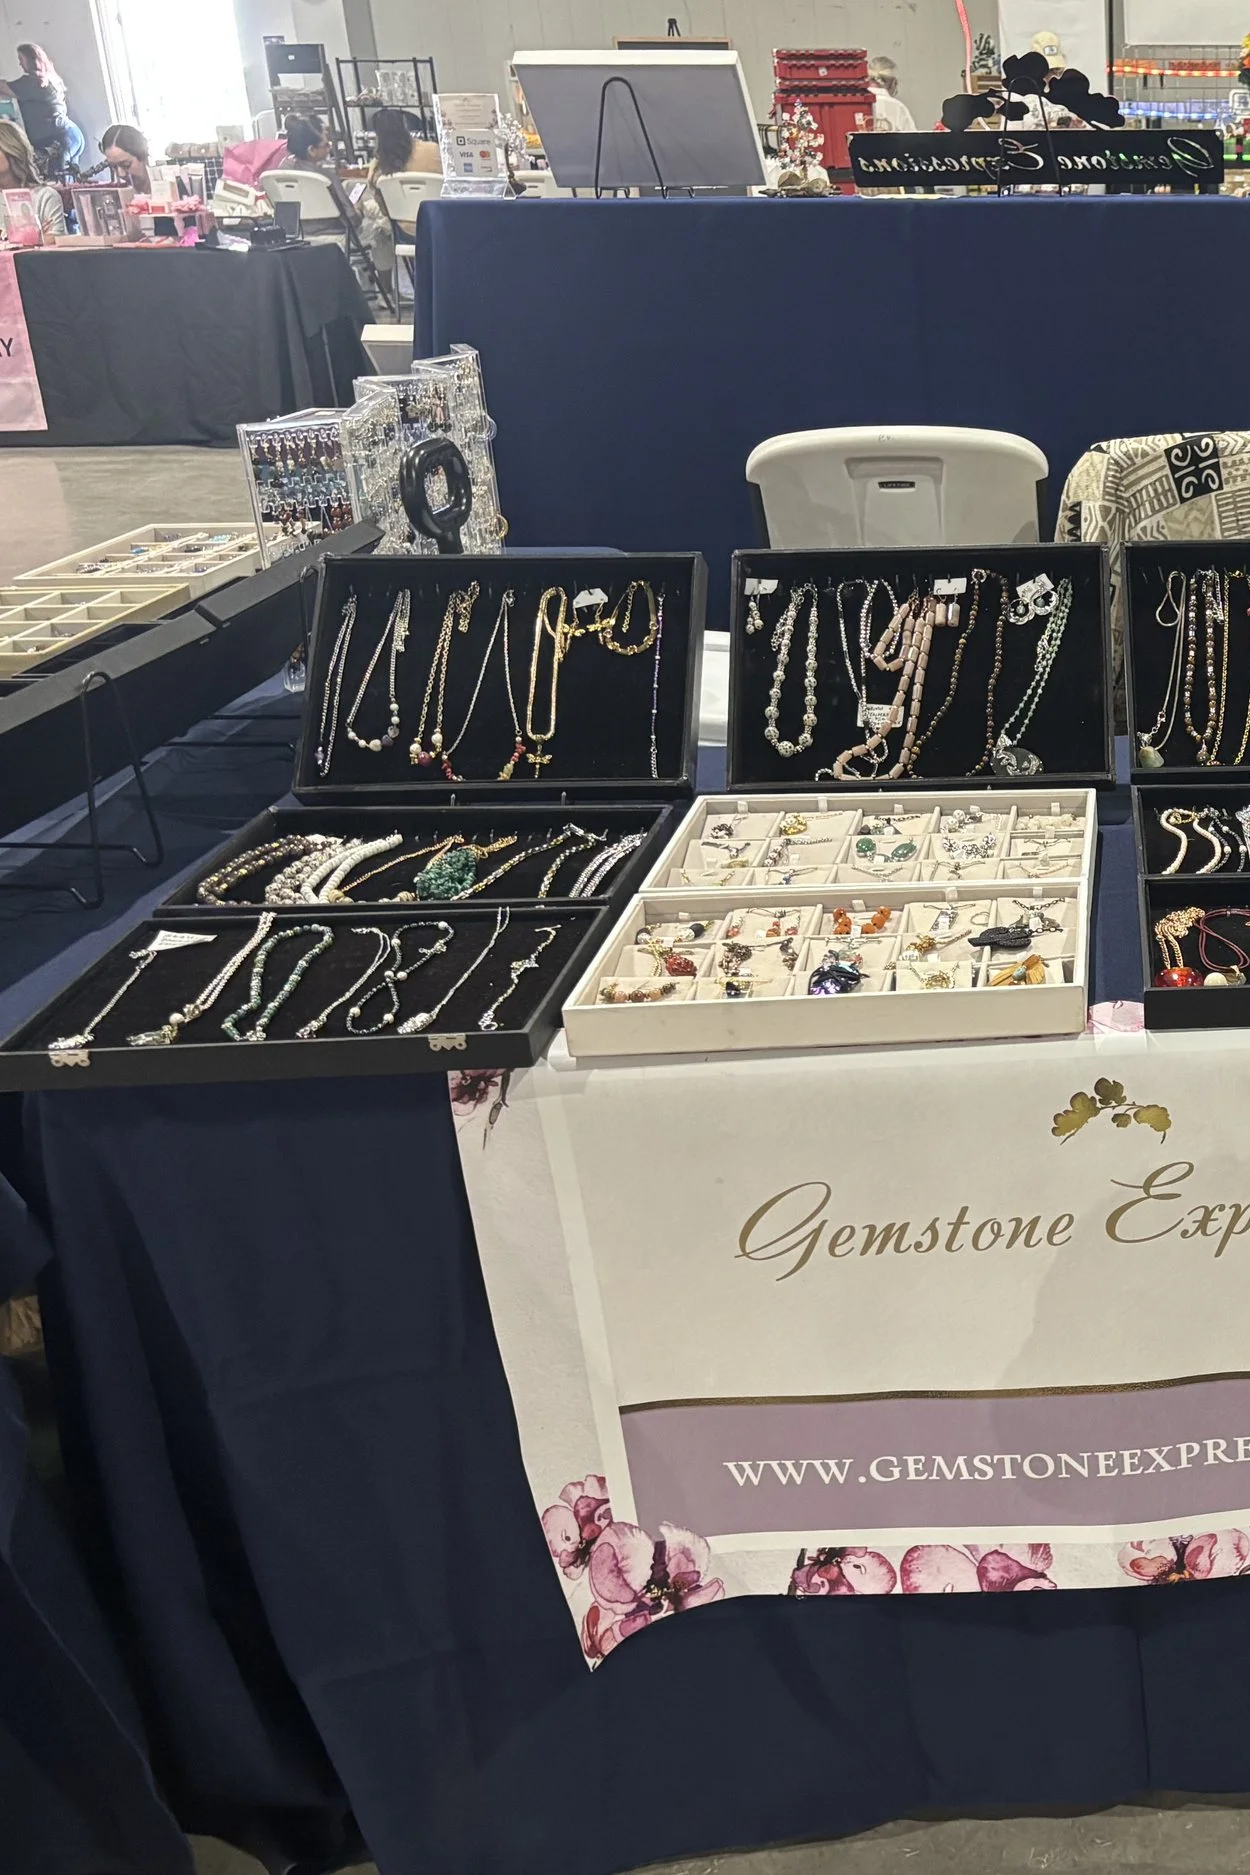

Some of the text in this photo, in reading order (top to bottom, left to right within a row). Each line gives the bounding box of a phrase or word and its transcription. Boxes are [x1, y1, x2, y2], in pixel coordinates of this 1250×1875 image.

[466, 137, 491, 146] Square
[0, 337, 14, 357] Y
[734, 1181, 1075, 1282] Gemstone
